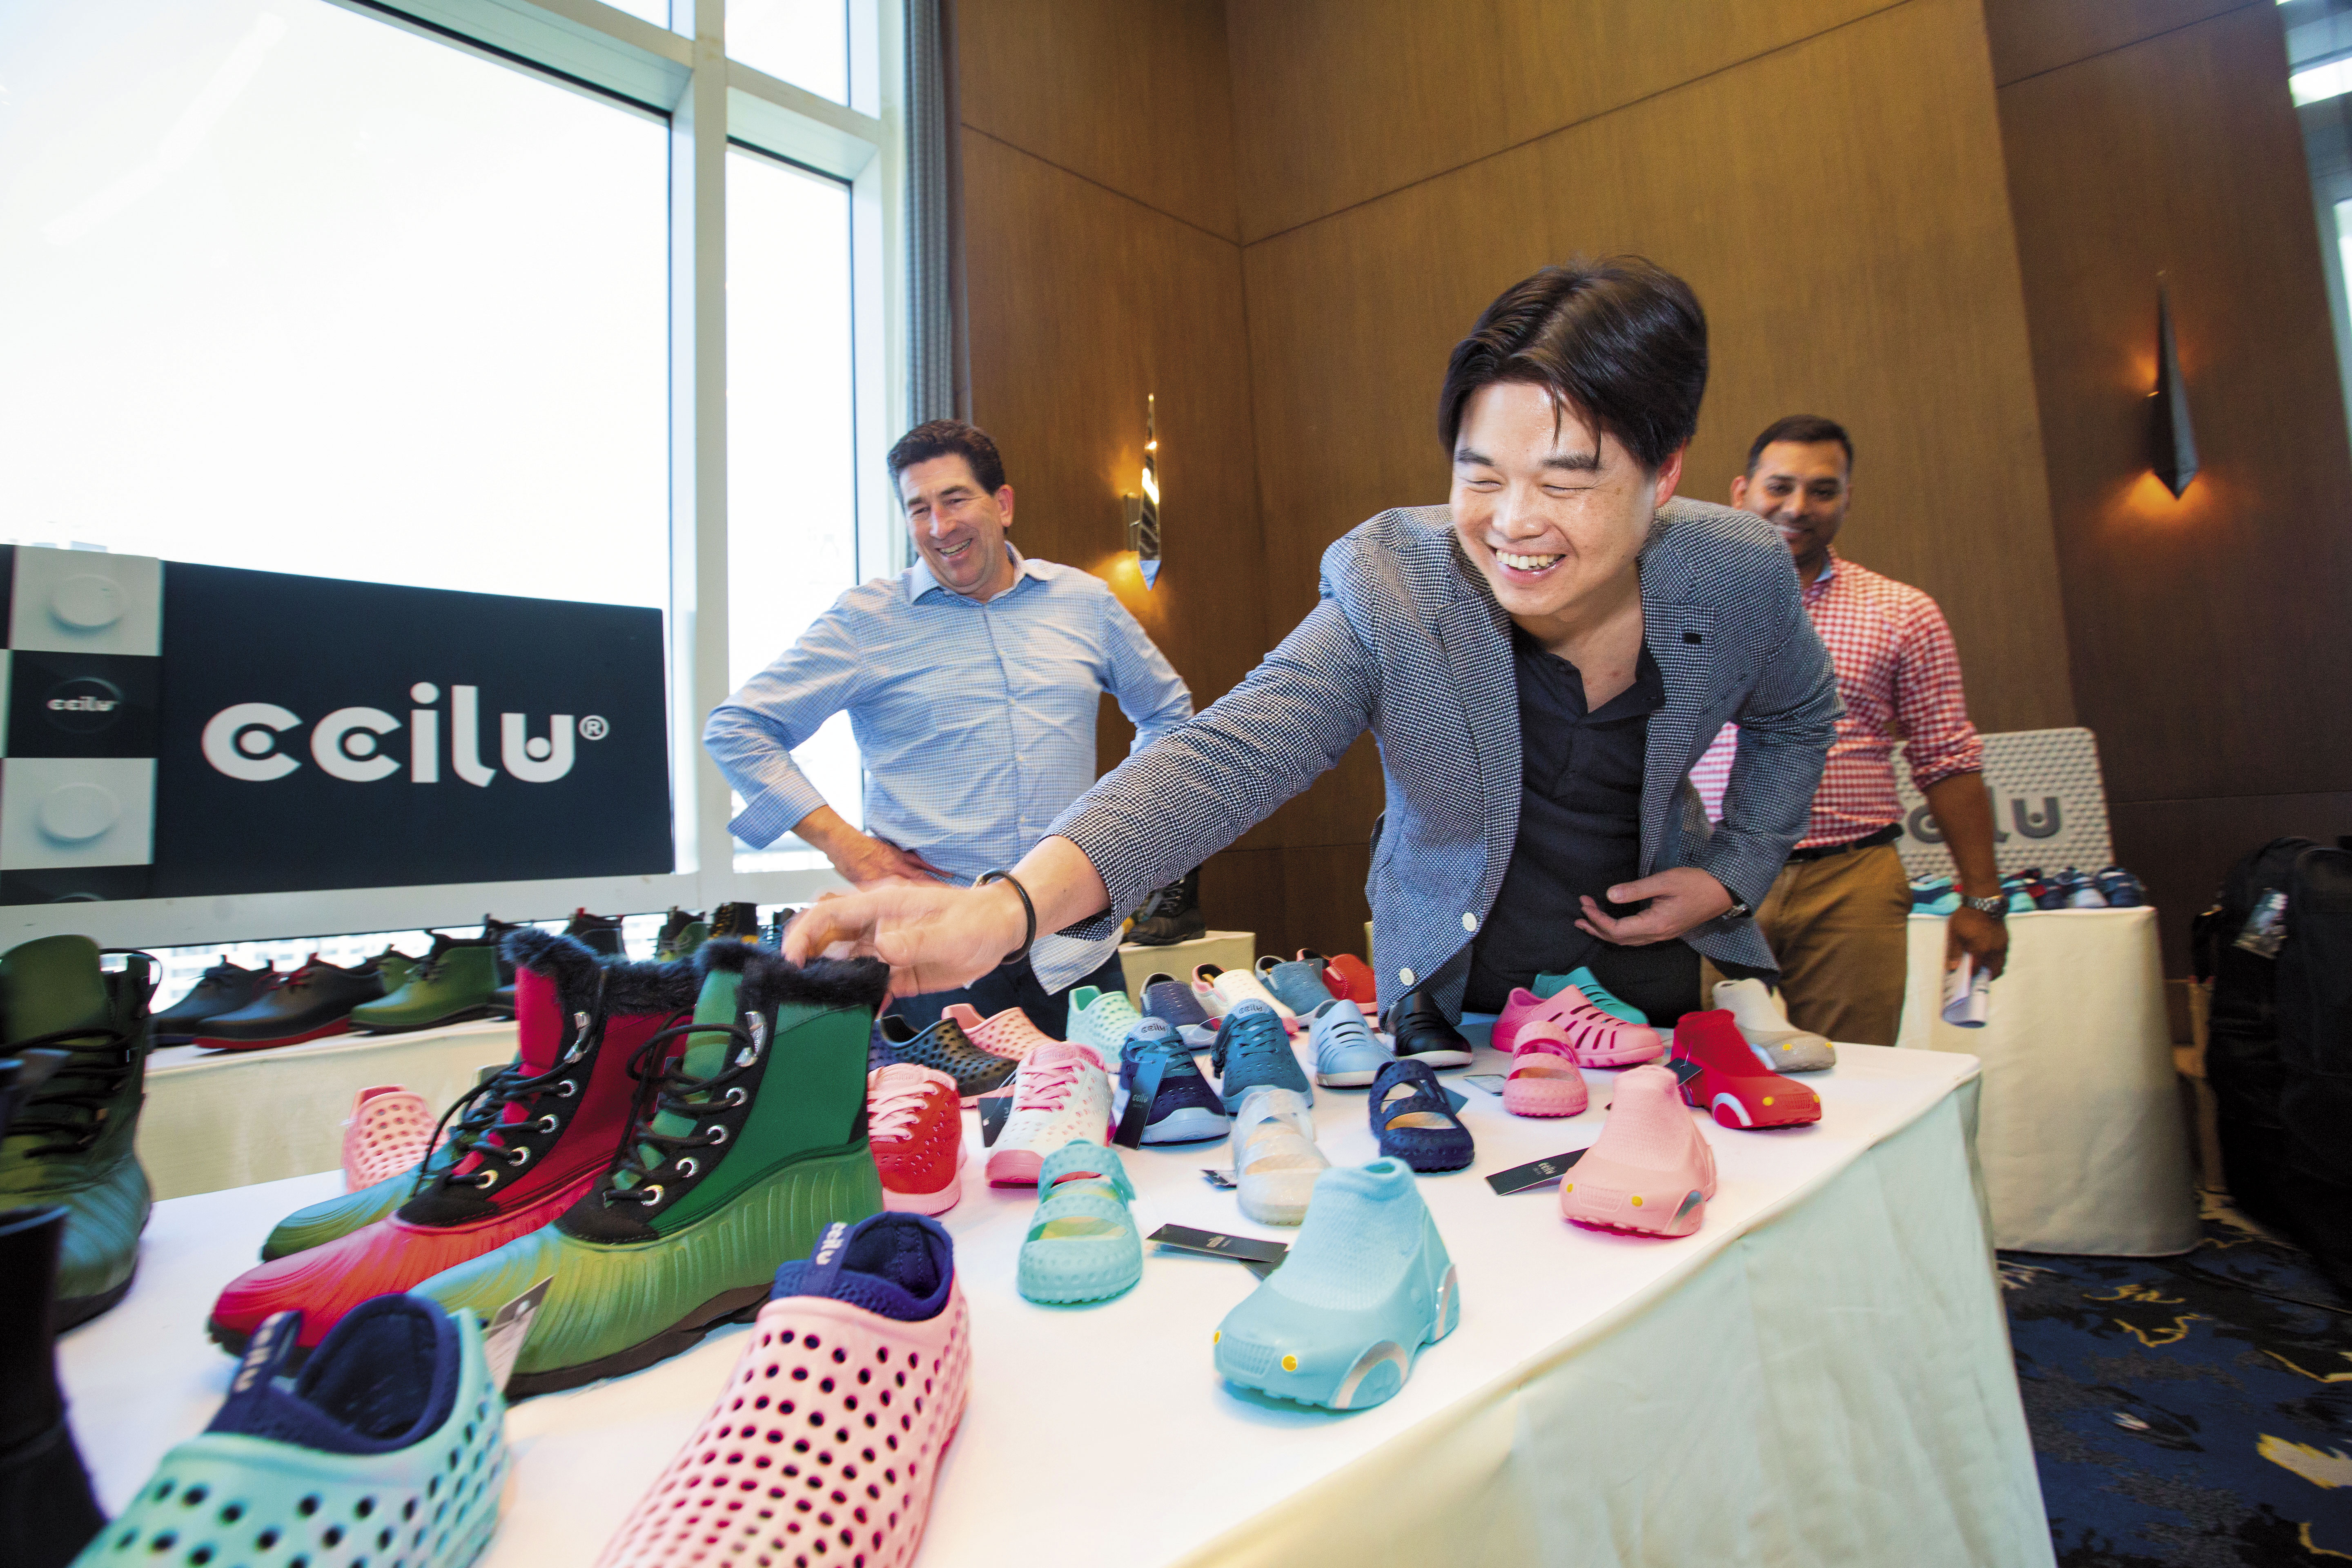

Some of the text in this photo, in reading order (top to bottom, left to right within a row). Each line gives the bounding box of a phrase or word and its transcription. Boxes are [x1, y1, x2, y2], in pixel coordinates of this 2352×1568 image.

[1239, 1004, 1263, 1014] ccilu
[1141, 1023, 1166, 1033] ccilu
[1132, 1093, 1148, 1103] ccilu
